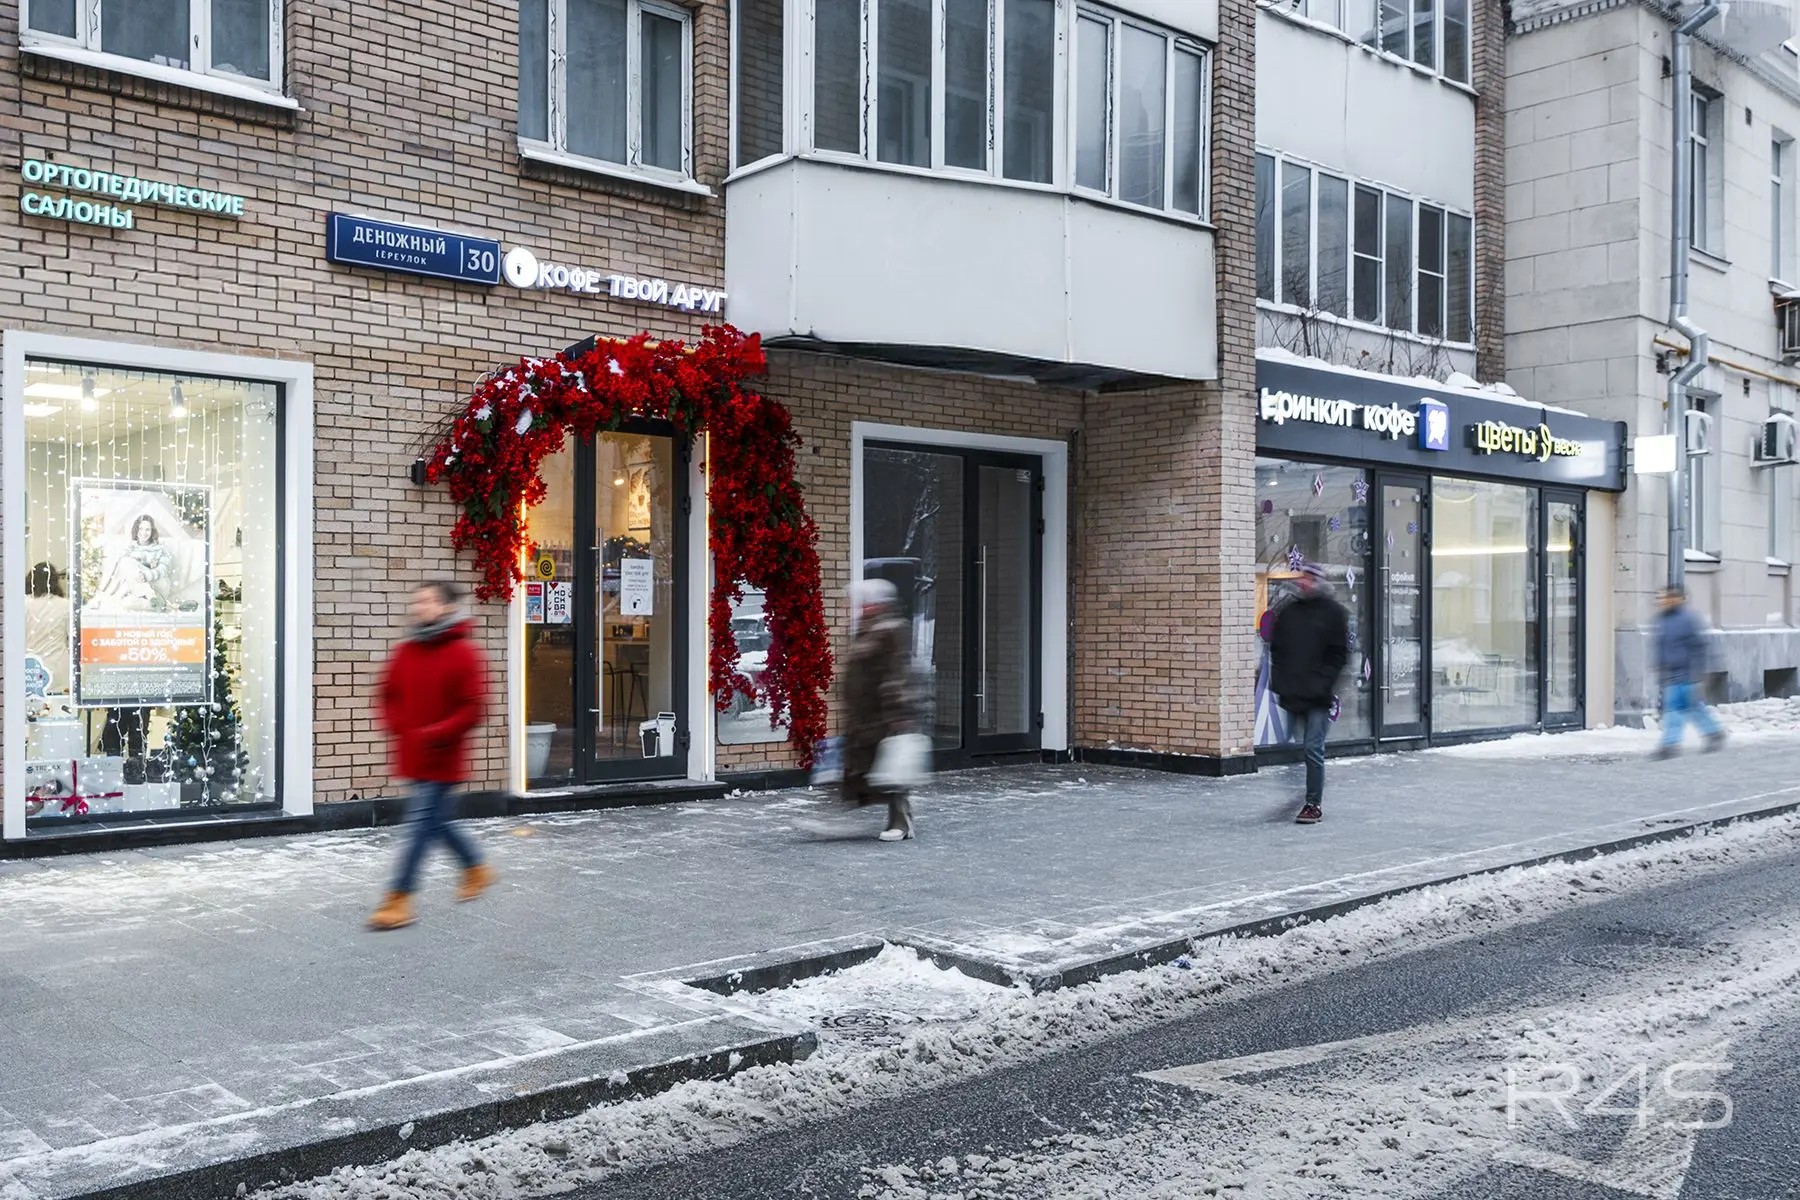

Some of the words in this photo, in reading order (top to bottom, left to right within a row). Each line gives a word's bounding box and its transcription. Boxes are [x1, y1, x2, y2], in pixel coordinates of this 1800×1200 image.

[22, 159, 245, 217] ОРТОПЕДИЧЕСКИЕ
[21, 192, 134, 230] САЛОНЫ
[467, 249, 495, 273] 30
[538, 262, 601, 294] КОФЕ
[607, 274, 669, 304] ТВОЙ
[670, 284, 728, 313] ДРУГ
[1364, 402, 1415, 441] кофе
[1478, 421, 1537, 455] цветы
